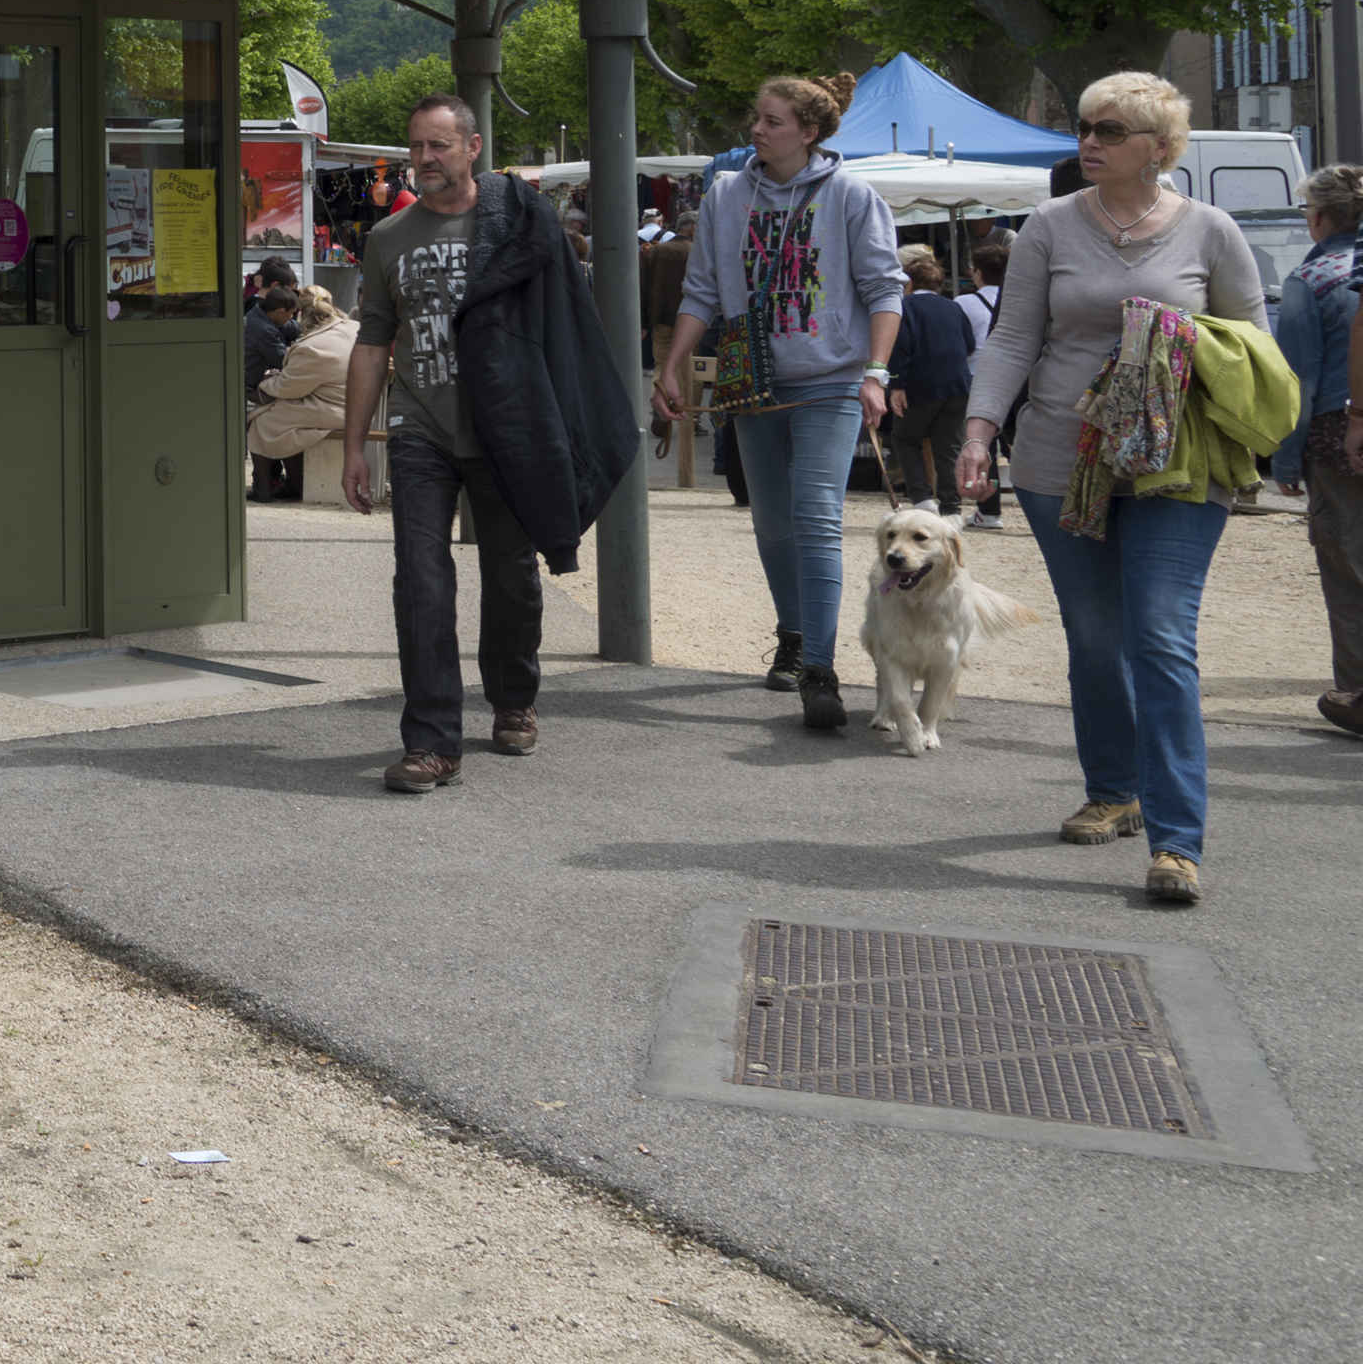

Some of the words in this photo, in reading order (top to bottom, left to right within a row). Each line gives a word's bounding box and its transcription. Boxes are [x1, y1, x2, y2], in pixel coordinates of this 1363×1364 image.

[156, 182, 174, 193] VIDE
[176, 185, 211, 201] GRENIER
[169, 172, 199, 192] FELINES
[398, 243, 469, 284] LOND
